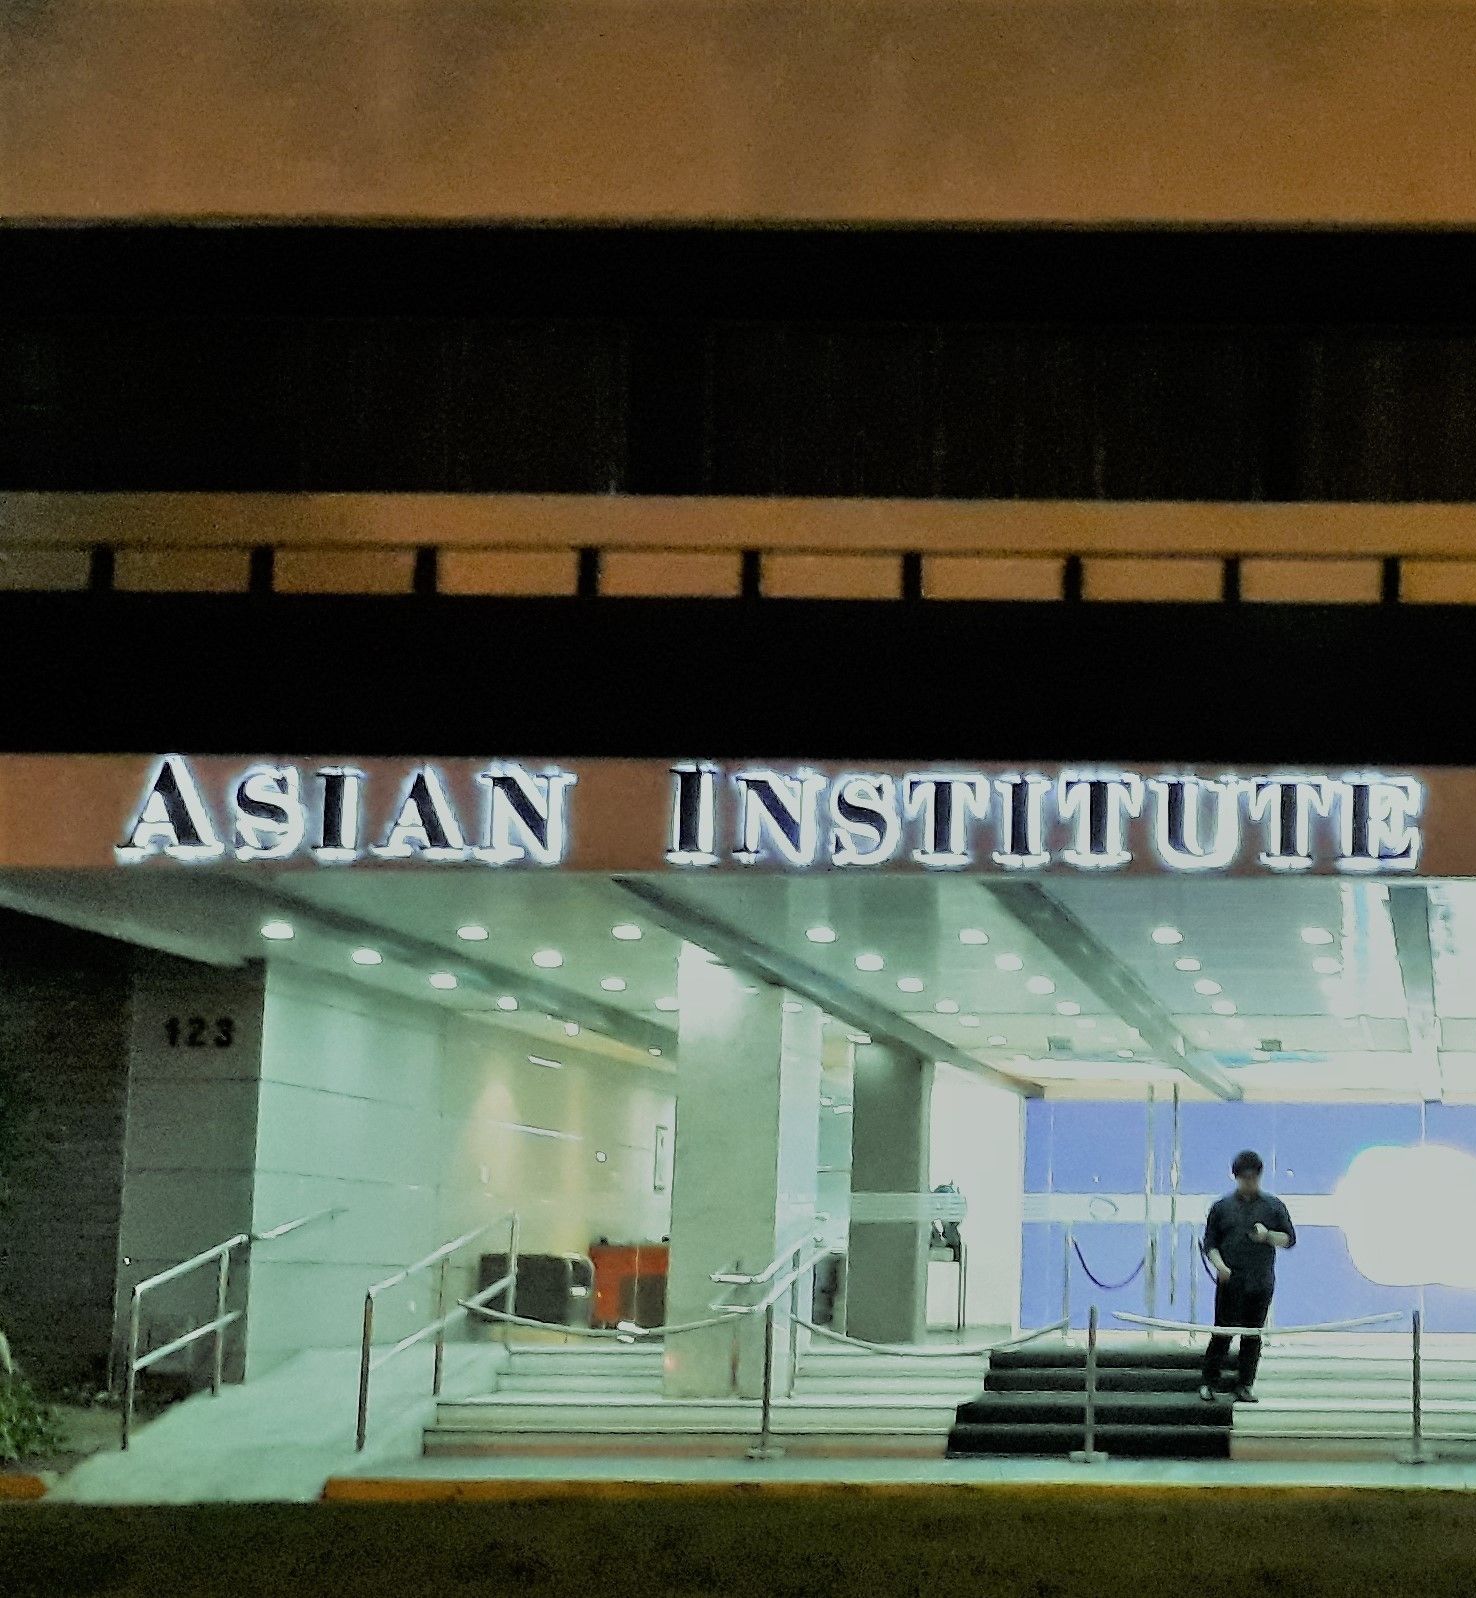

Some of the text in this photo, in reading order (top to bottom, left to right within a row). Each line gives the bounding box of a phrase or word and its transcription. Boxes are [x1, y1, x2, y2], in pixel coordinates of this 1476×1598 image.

[114, 753, 577, 865] ASIAN
[665, 762, 1421, 870] INSTITUTE
[164, 1017, 234, 1048] 123
